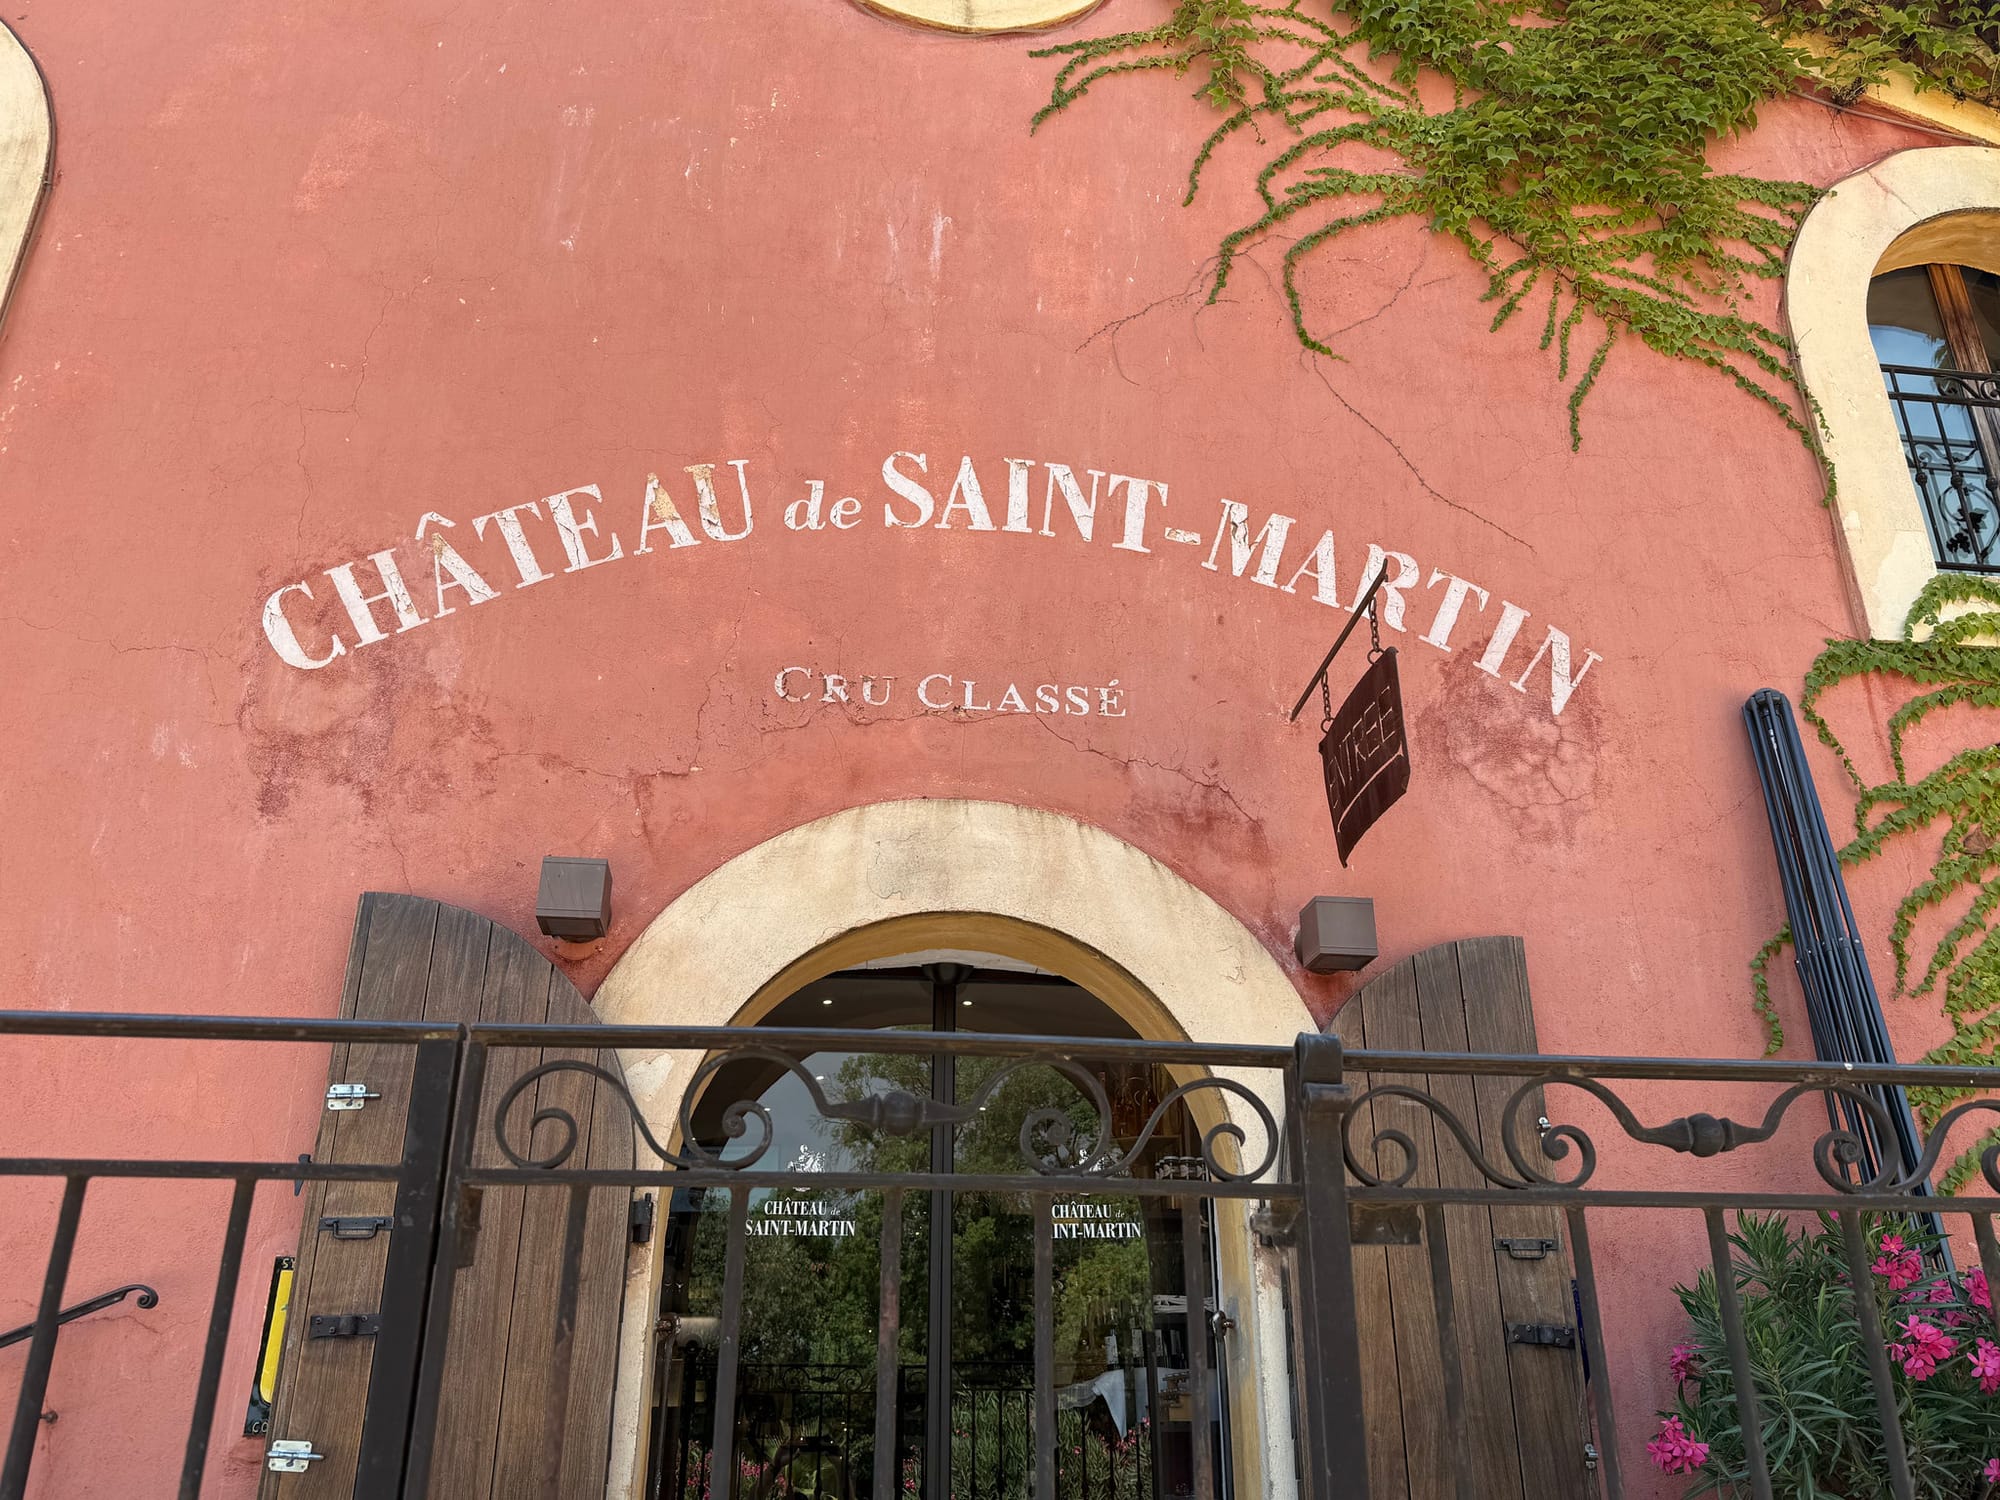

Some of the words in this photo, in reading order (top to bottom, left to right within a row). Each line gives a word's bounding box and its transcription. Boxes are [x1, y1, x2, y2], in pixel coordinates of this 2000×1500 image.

[260, 459, 755, 670] CHÂTEAU
[783, 479, 864, 532] de
[774, 666, 897, 706] CRU
[917, 673, 1127, 717] CLASSÉ
[764, 1196, 828, 1216] CHÂTEAU
[830, 1207, 841, 1216] de
[1051, 1200, 1112, 1219] CHÂTEAU
[1115, 1209, 1125, 1218] de
[744, 1219, 856, 1237] SAINT-MARTIN
[1051, 1222, 1142, 1239] INT-MARTIN
